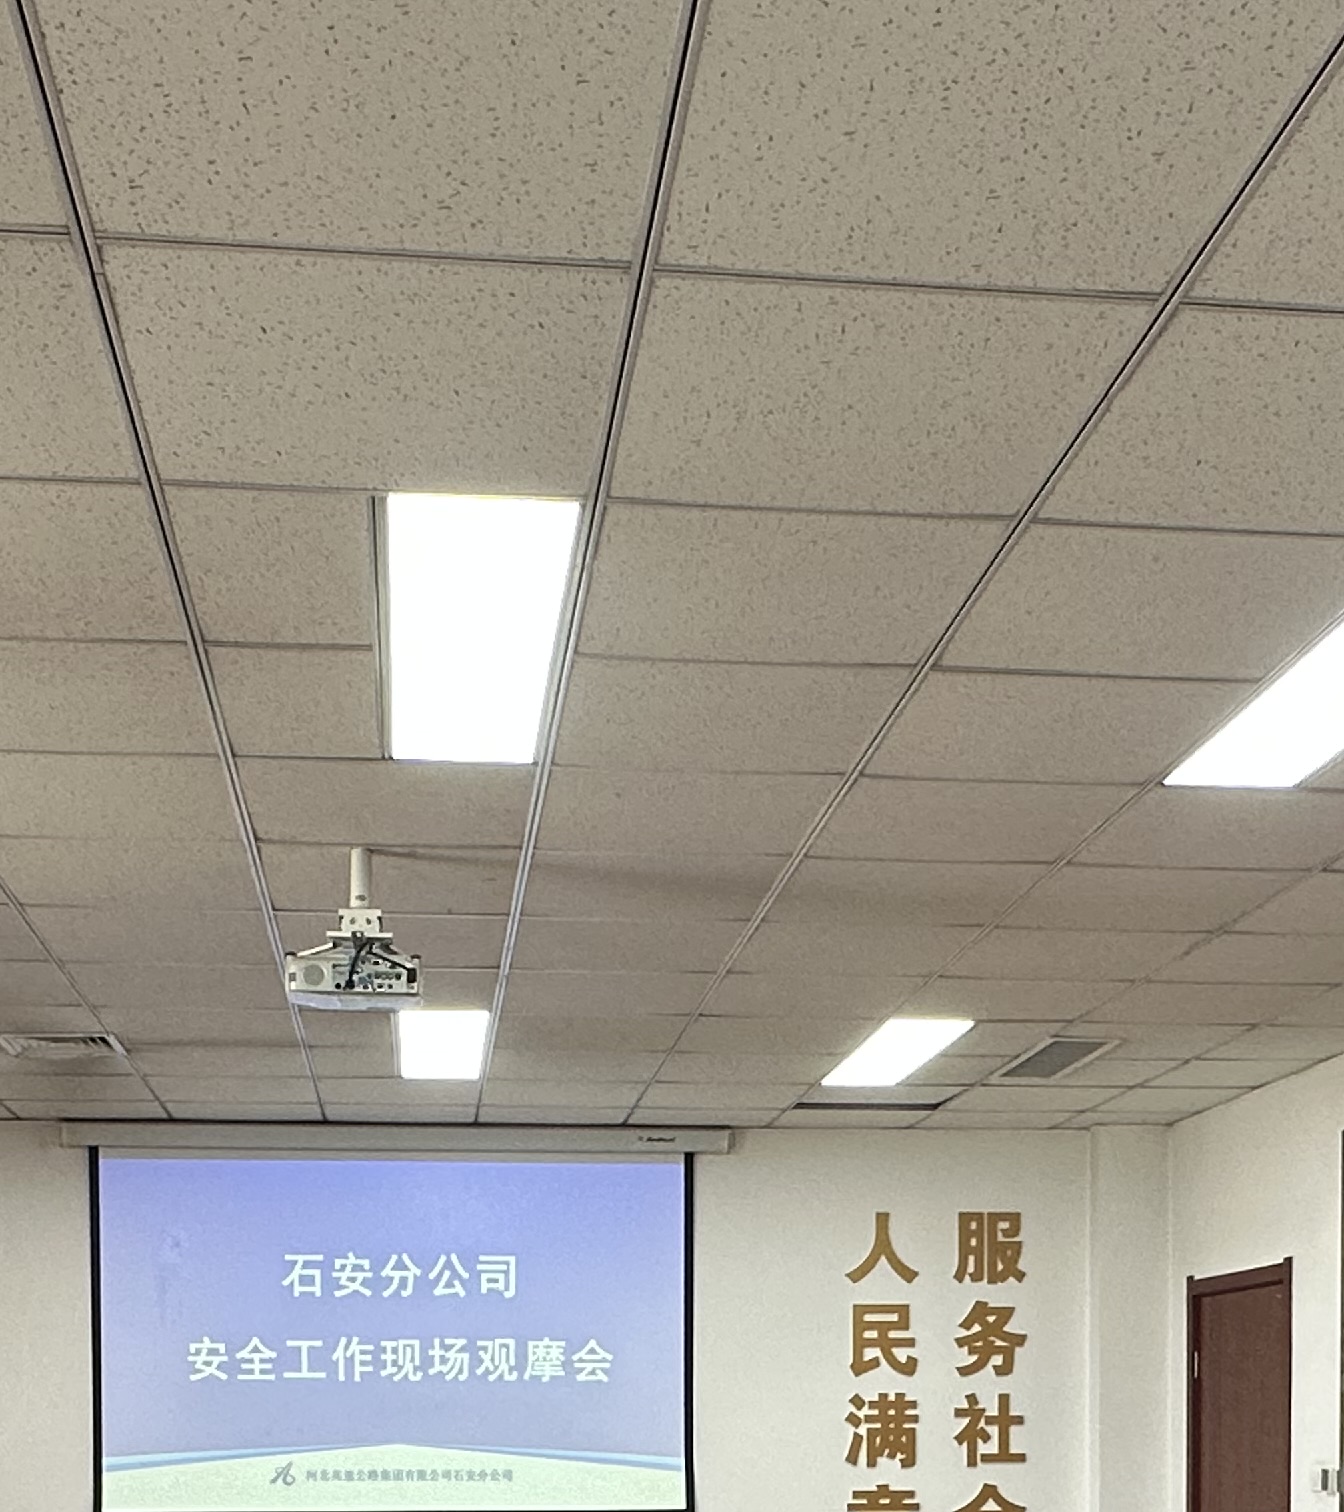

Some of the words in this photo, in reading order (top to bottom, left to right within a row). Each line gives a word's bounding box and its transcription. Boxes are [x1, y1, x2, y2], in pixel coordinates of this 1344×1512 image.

[281, 1252, 519, 1299] 石安分公司
[186, 1336, 615, 1384] 安全工作现场观摩会
